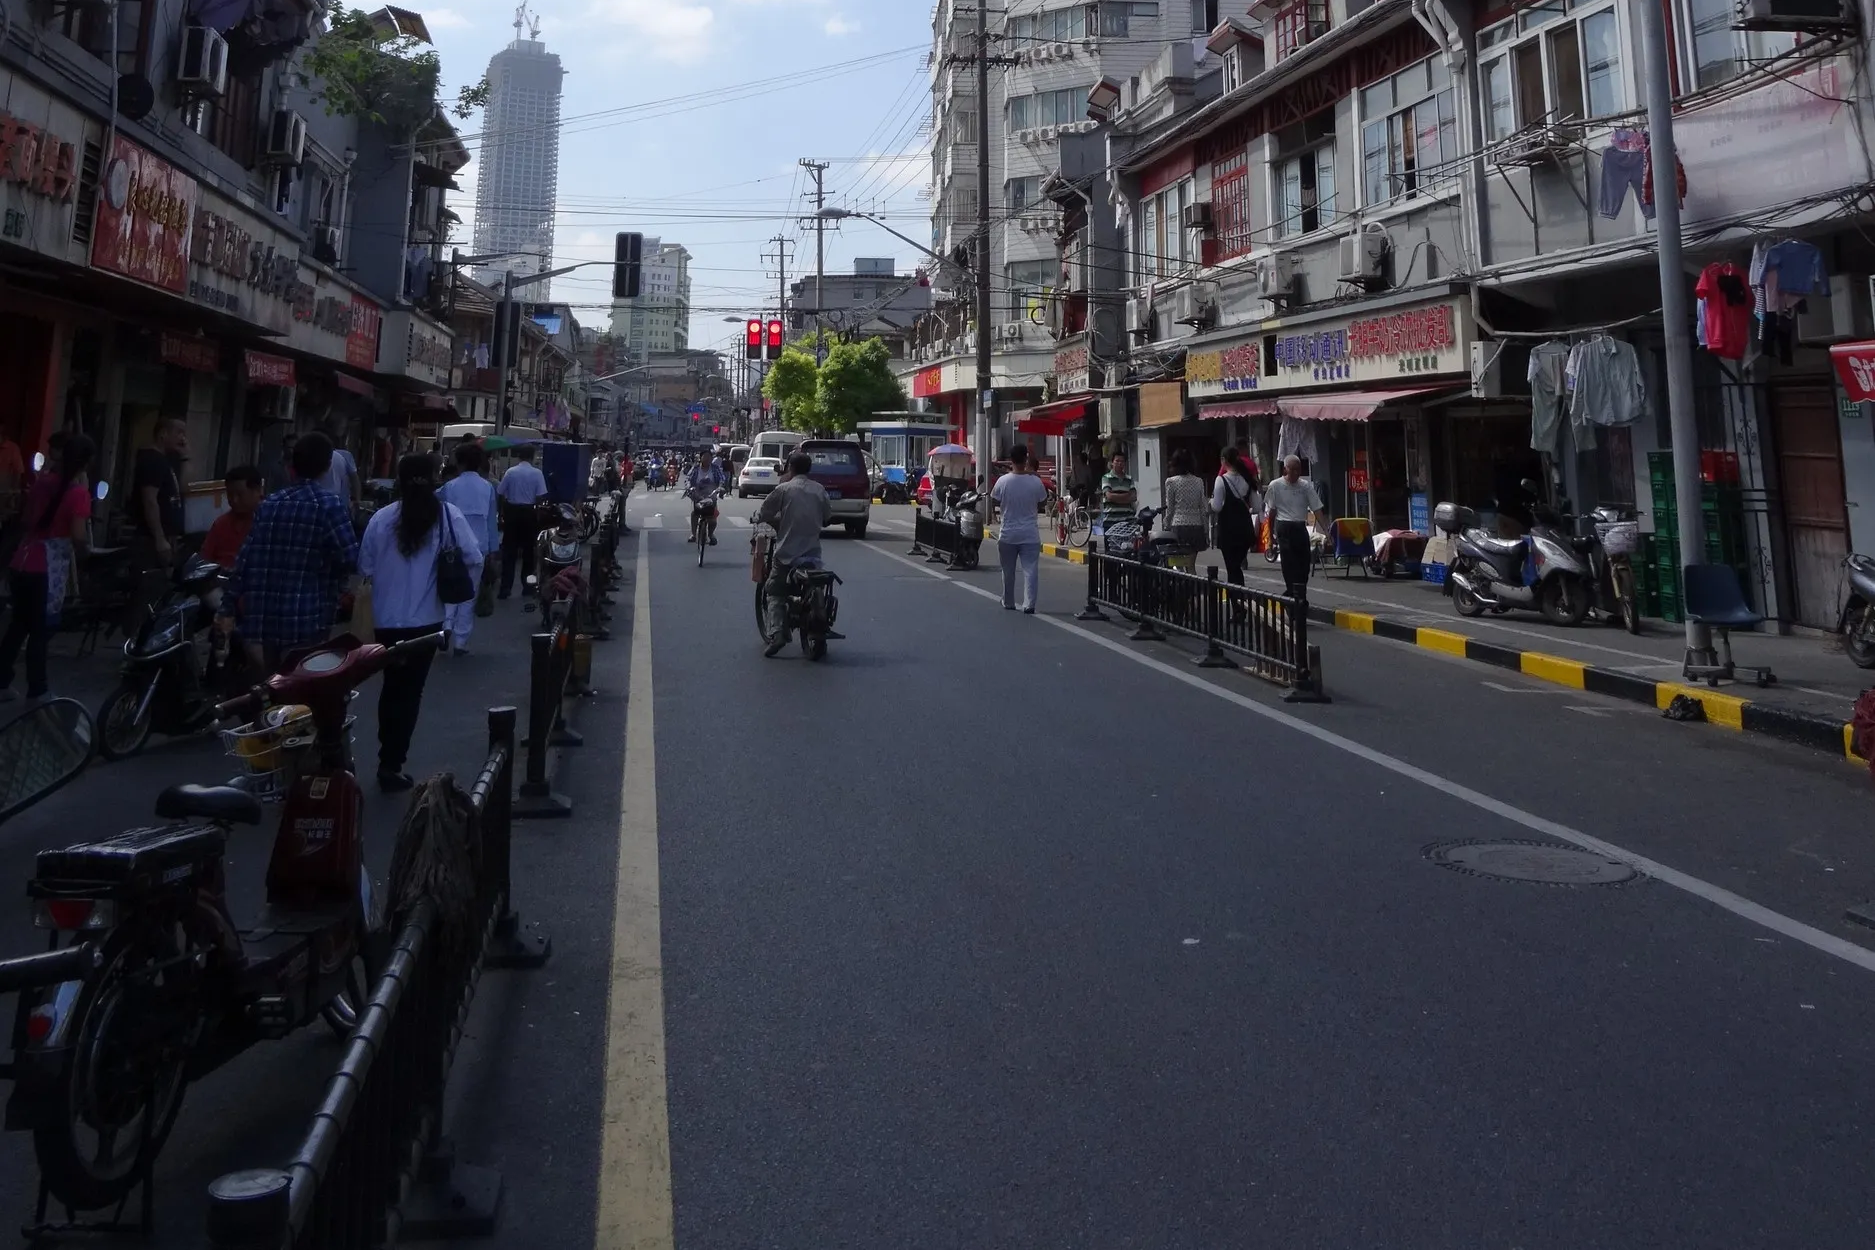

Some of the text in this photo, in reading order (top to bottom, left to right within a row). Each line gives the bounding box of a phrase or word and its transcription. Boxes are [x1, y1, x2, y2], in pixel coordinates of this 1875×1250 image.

[1274, 330, 1346, 367] 中国移动通讯
